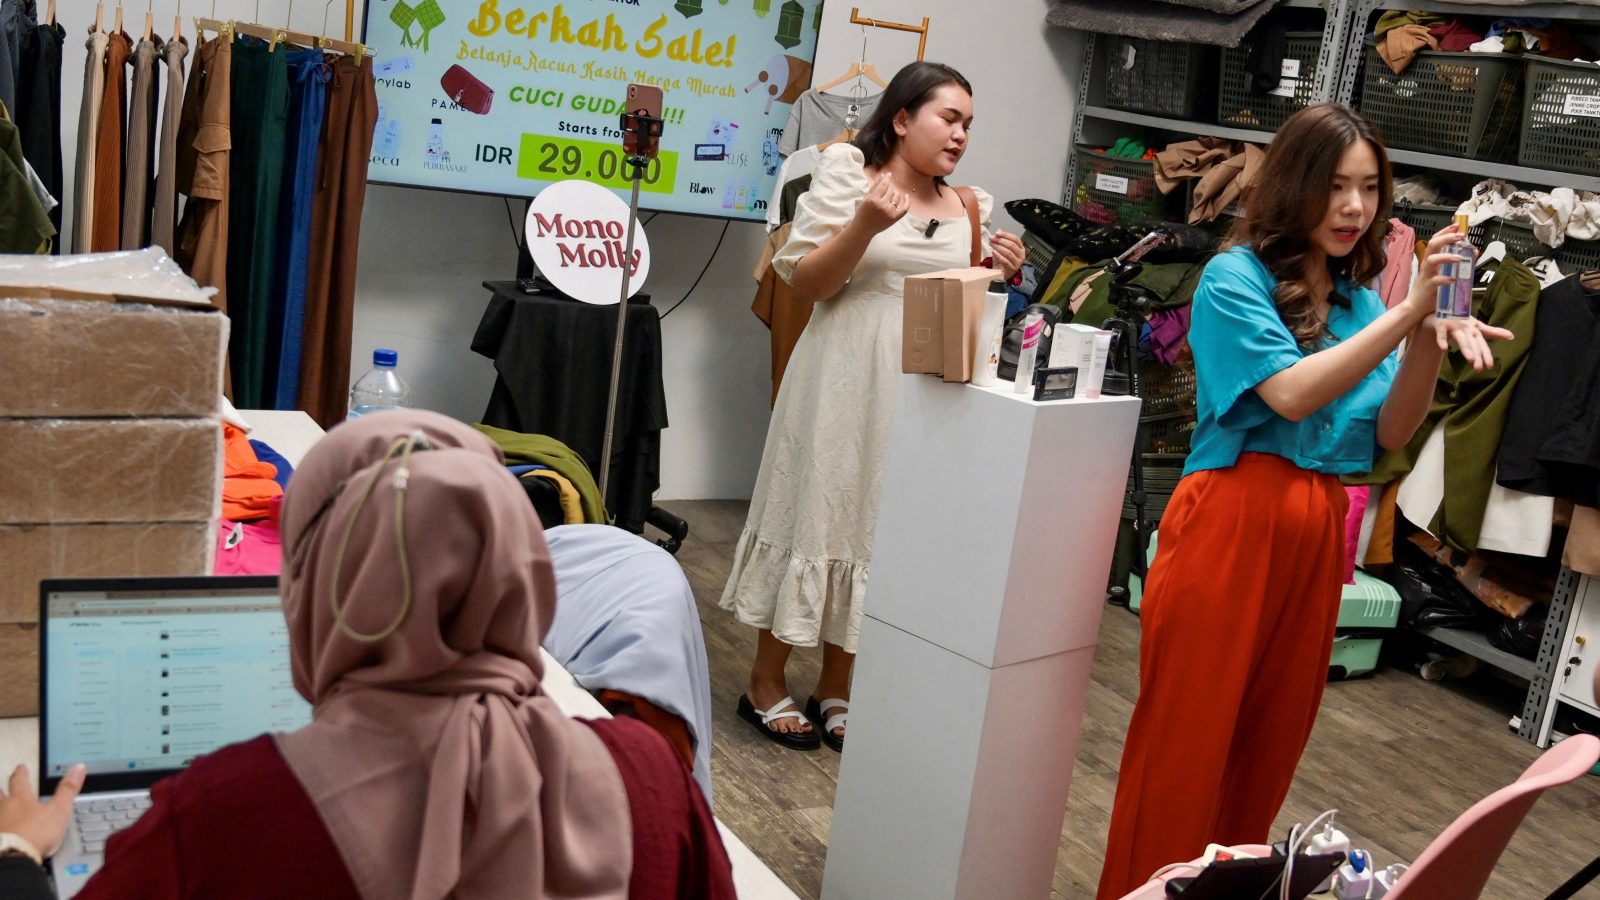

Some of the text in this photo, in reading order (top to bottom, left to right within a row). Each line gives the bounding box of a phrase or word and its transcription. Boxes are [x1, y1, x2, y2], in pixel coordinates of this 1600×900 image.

[467, 0, 737, 69] Berkah Sale!
[455, 40, 737, 98] Belanja Racun Kasih Harga Murah
[431, 99, 470, 112] PAME
[510, 86, 563, 108] CUCI
[559, 121, 597, 136] Starts
[475, 143, 513, 165] IDR
[533, 212, 624, 239] Mono
[556, 240, 641, 277] Molly
